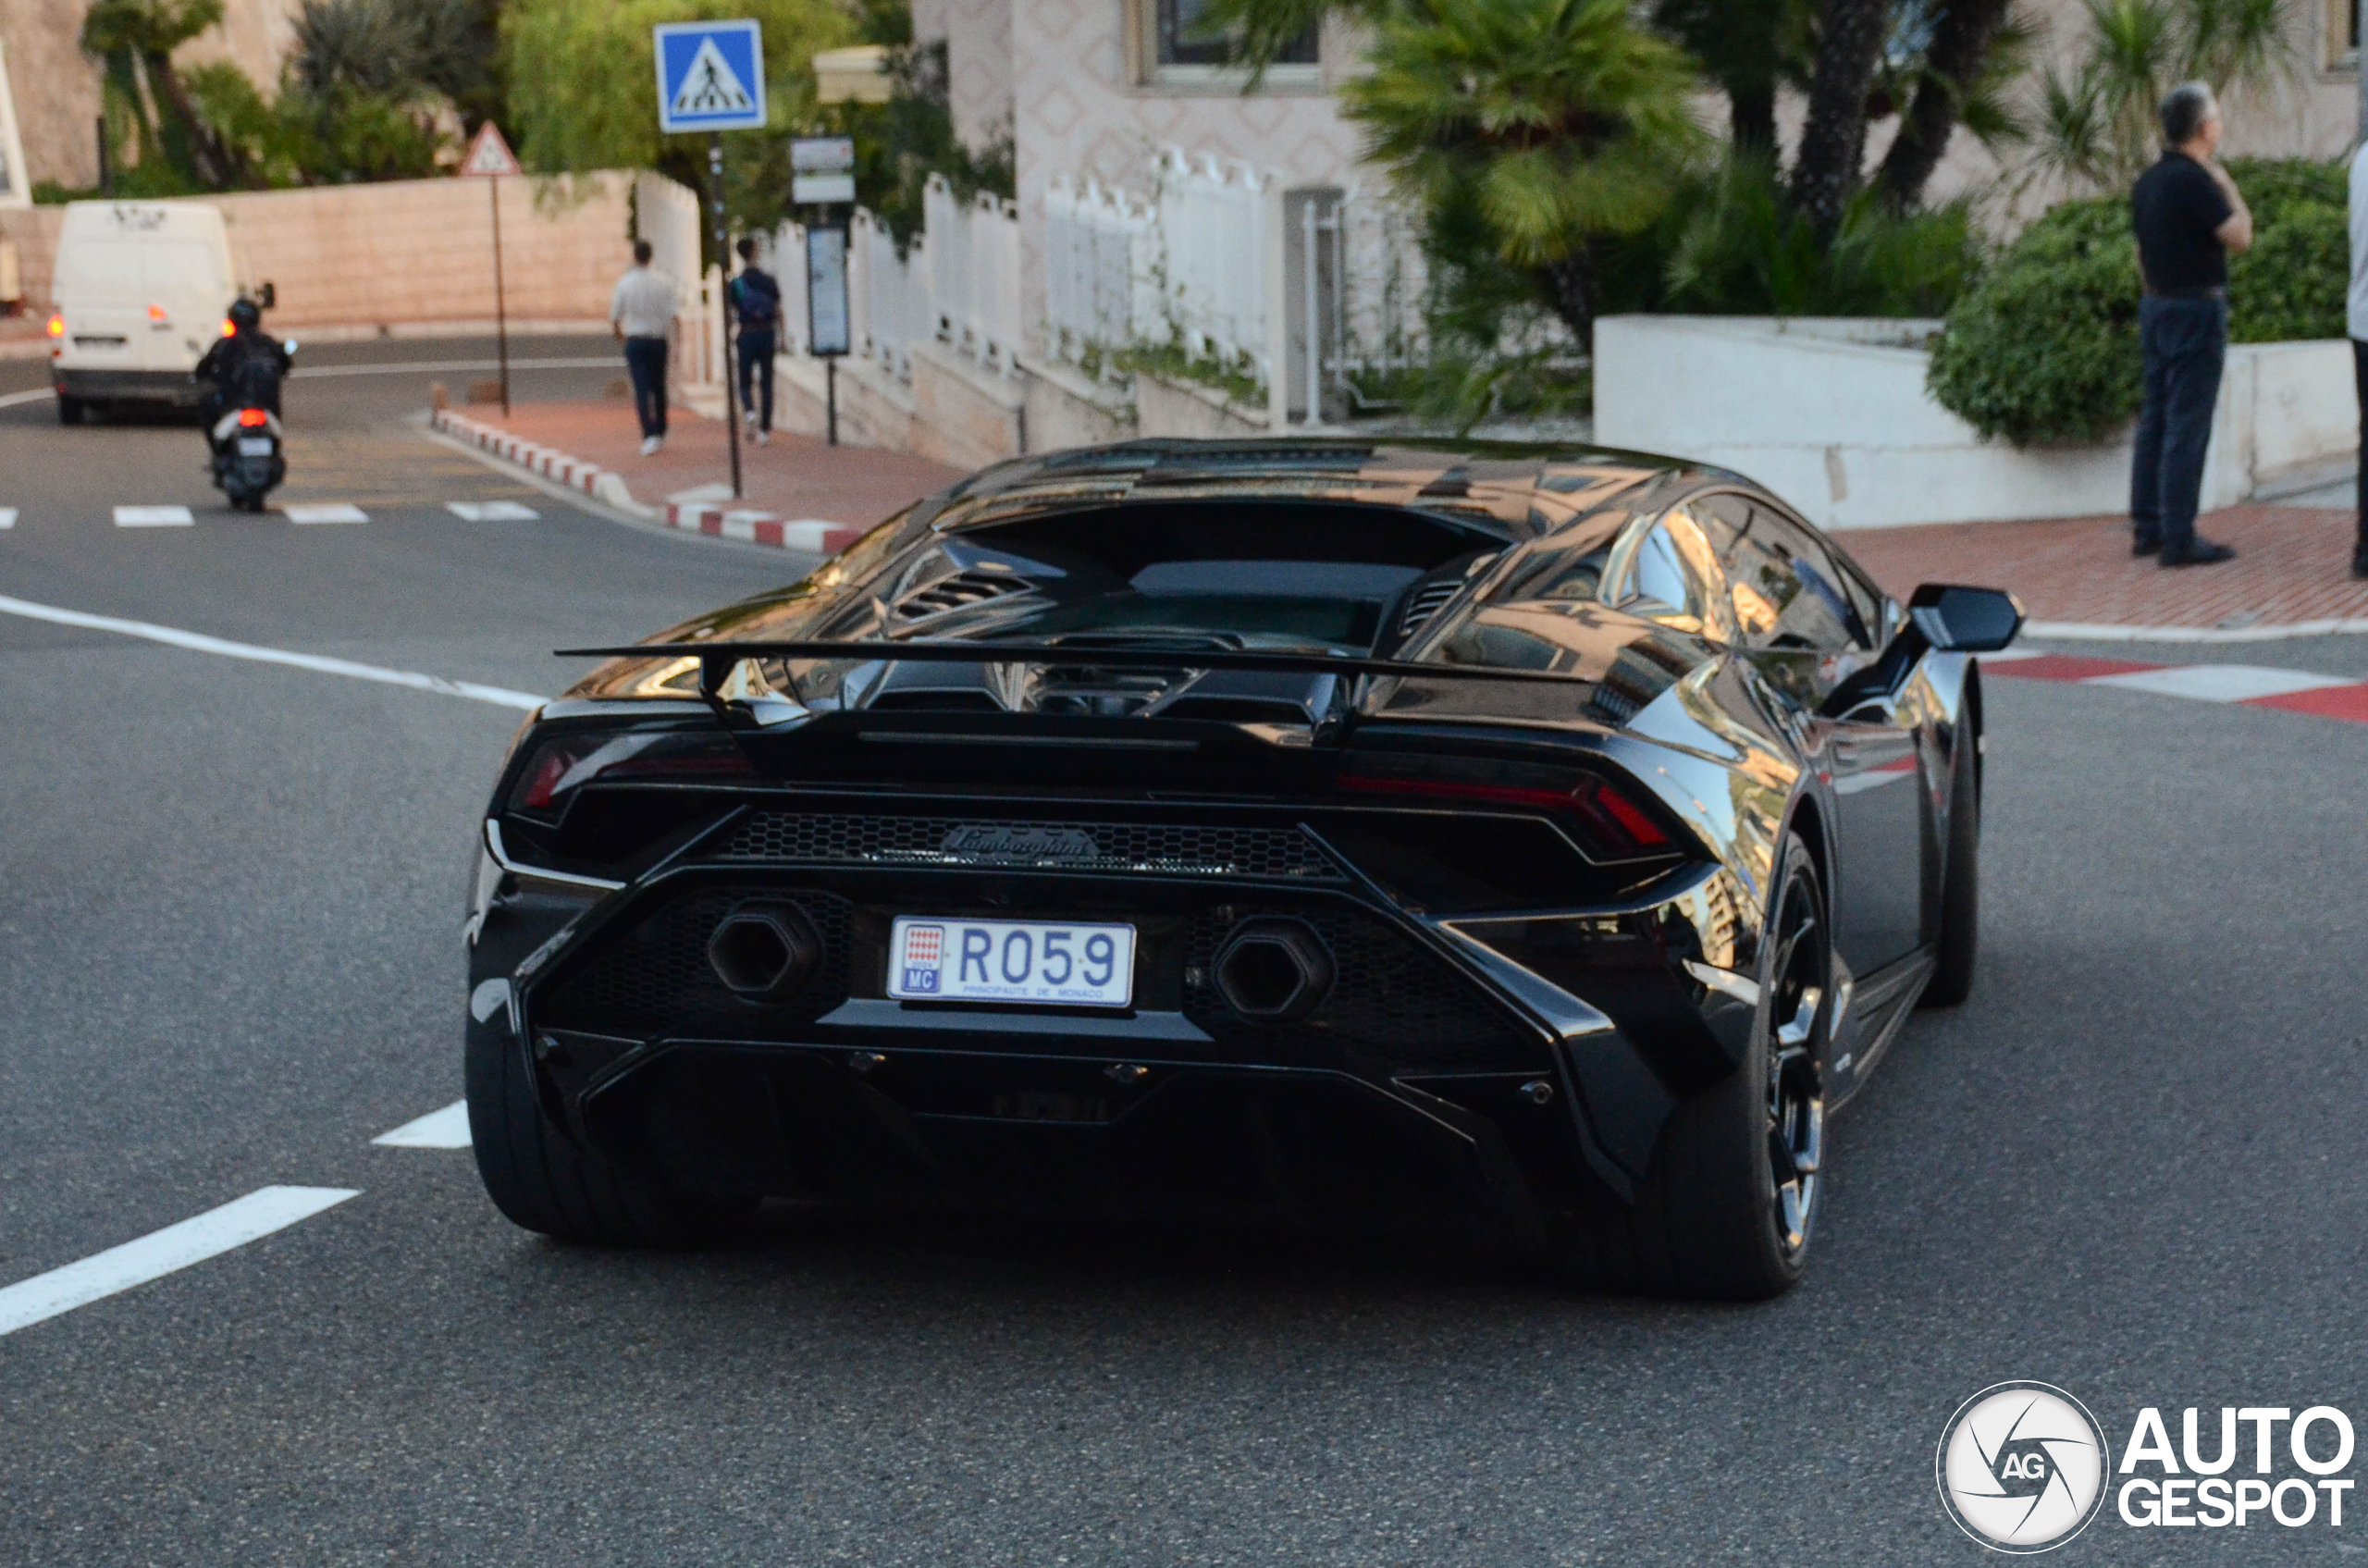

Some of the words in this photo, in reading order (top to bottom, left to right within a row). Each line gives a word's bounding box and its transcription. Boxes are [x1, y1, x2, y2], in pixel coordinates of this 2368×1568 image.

[959, 928, 1115, 987] R059
[908, 970, 933, 989] MC
[963, 985, 1028, 996] PRINCIPAUTE
[1037, 987, 1050, 996] DE
[1057, 989, 1104, 998] MONACO
